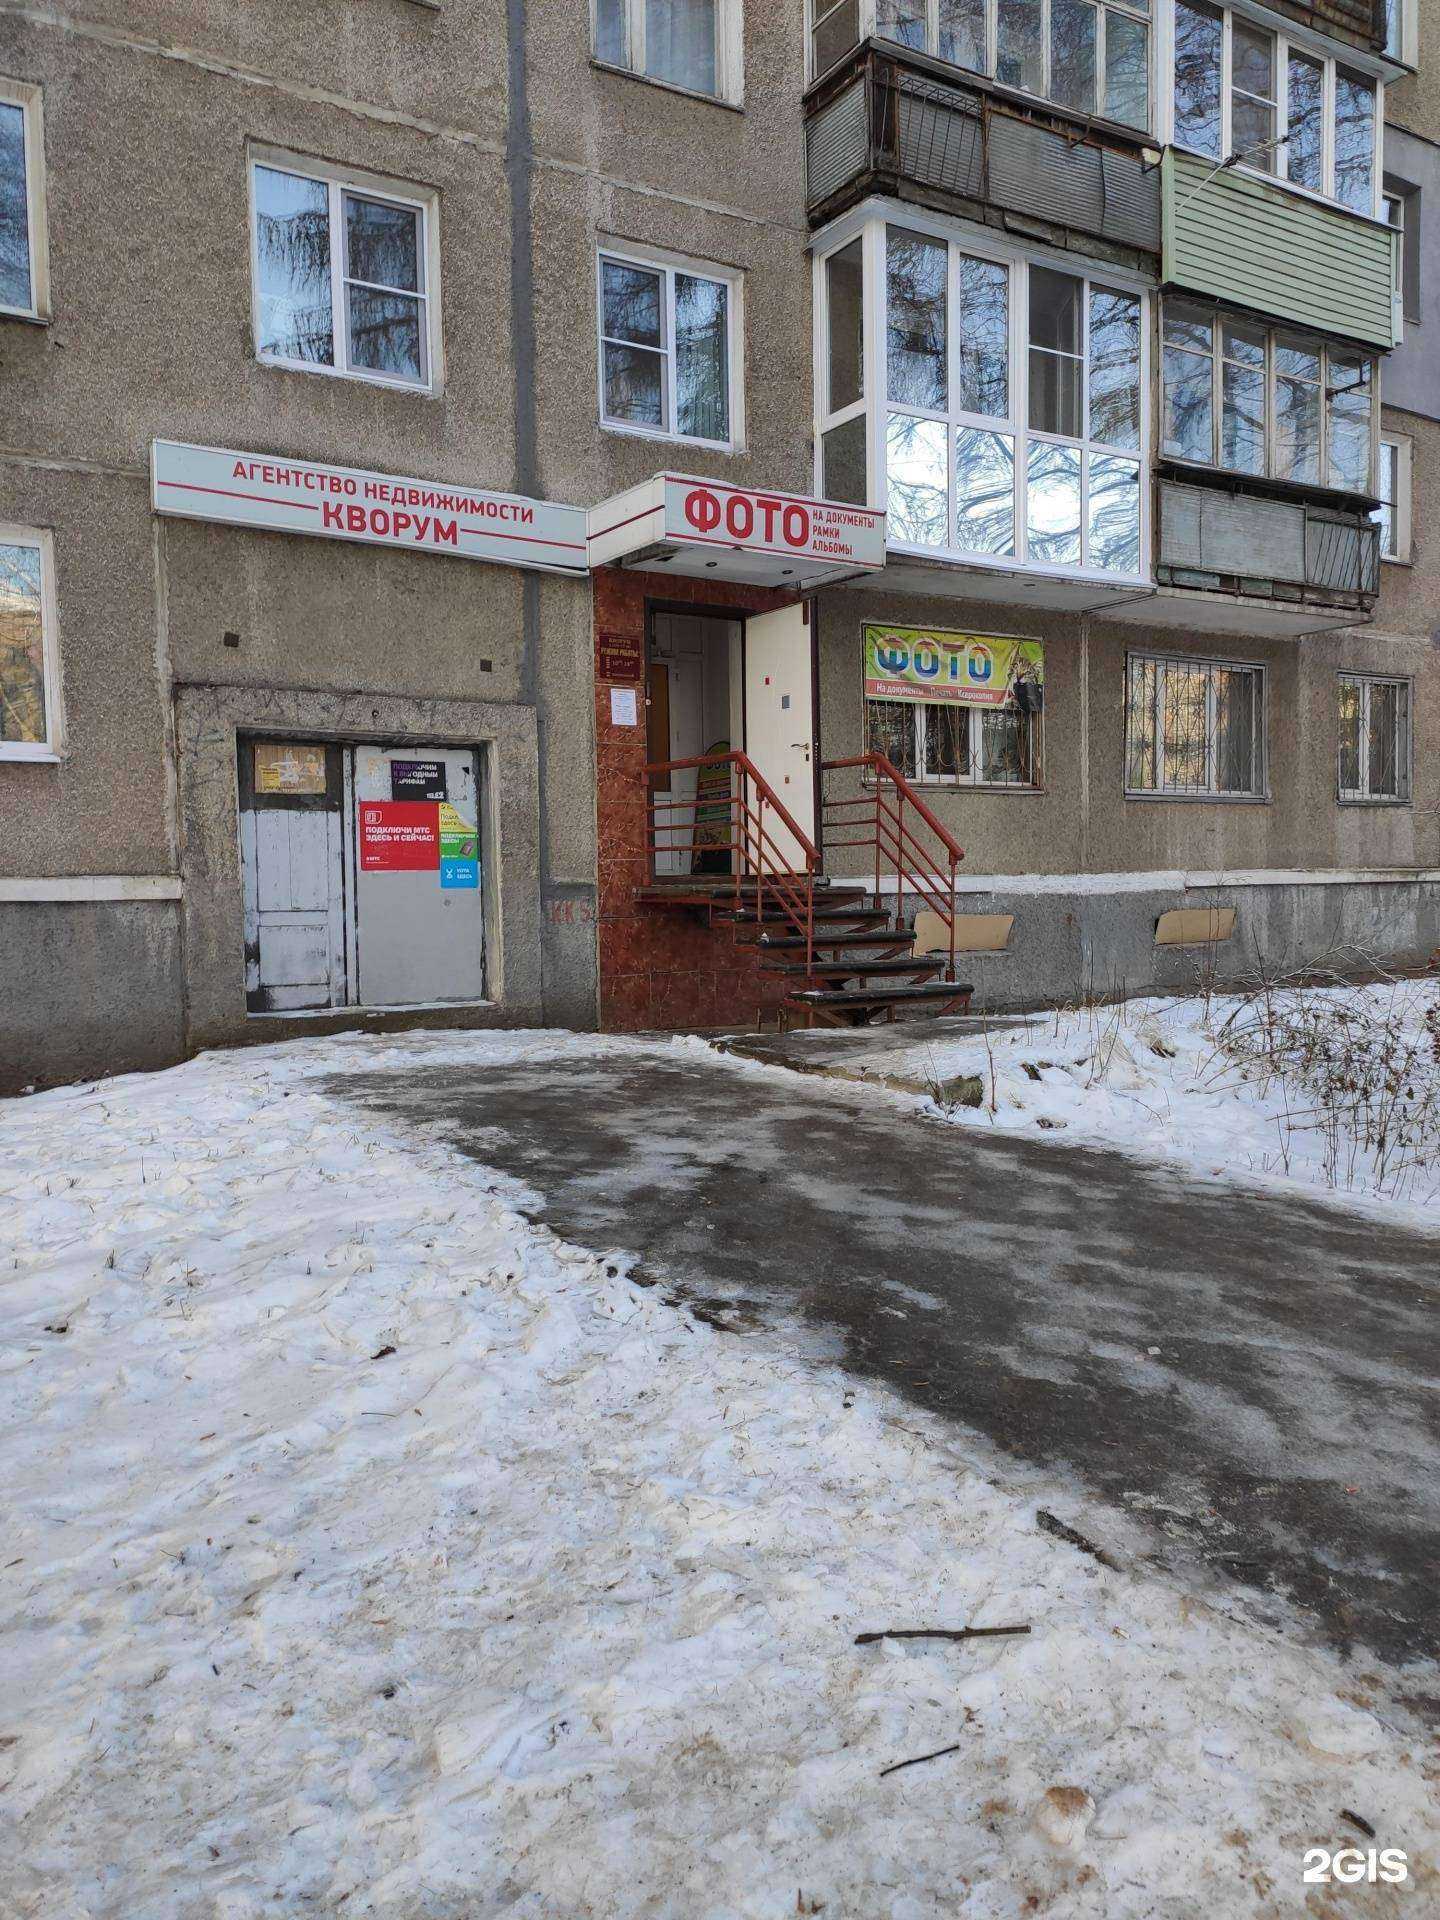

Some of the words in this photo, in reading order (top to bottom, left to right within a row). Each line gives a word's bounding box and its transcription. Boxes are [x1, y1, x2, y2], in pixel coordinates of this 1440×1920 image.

[232, 461, 357, 496] АГЕНТСТВО
[364, 482, 533, 524] НЕДВИЖИМОСТИ
[322, 501, 458, 545] КВОРУМ
[685, 489, 810, 547] ФОТО
[813, 509, 824, 521] НА
[826, 511, 875, 529] ДОКУМЕНТЫ
[813, 526, 840, 539] РАМКИ
[812, 540, 853, 556] АЛЬБОМЫ
[875, 634, 994, 684] ФОТО
[876, 682, 886, 693] На
[365, 826, 412, 834] ПОДКЛЮЧИ
[413, 826, 430, 834] МТС
[365, 834, 392, 842] ЗДЕСЬ
[393, 834, 400, 842] И
[400, 833, 434, 842] СЕЙЧАС!
